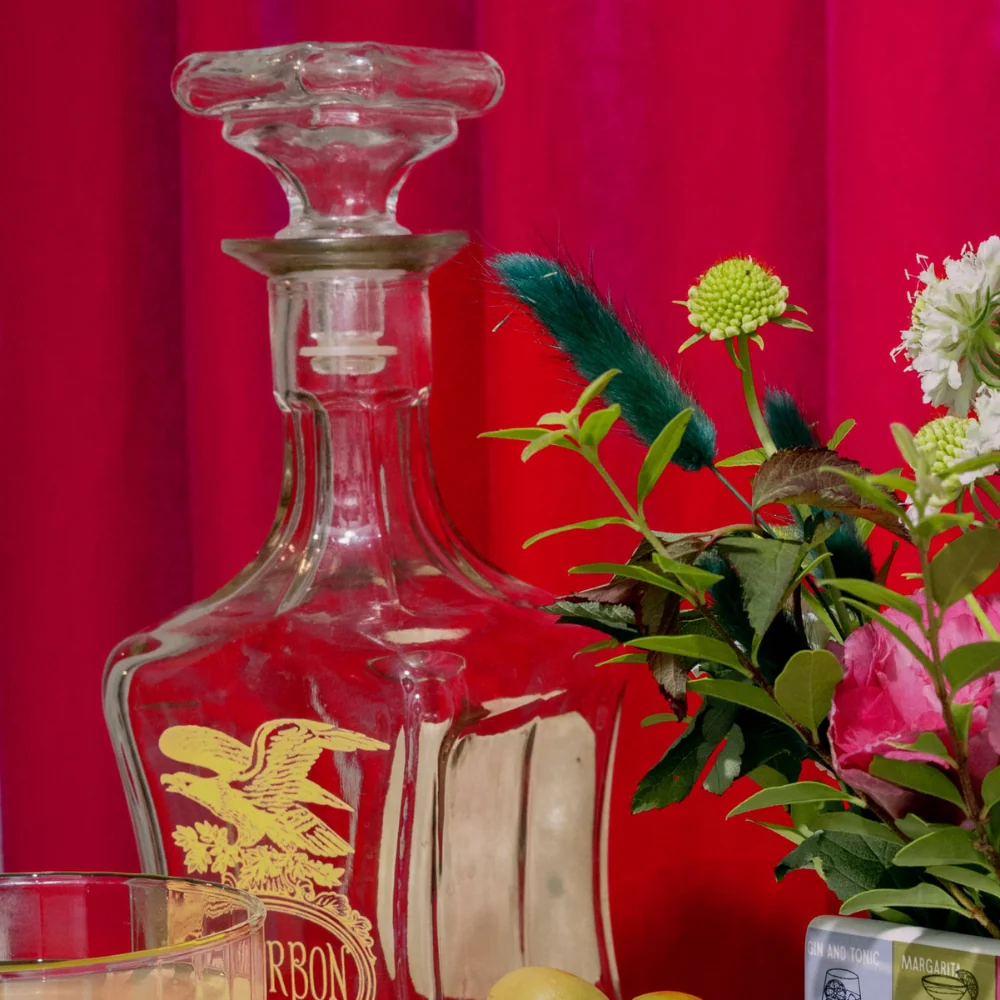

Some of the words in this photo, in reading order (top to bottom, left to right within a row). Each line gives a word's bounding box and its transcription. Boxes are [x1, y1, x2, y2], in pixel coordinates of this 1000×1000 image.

[808, 941, 824, 957] GIN
[827, 944, 846, 961] AND
[850, 946, 880, 967] TONIC
